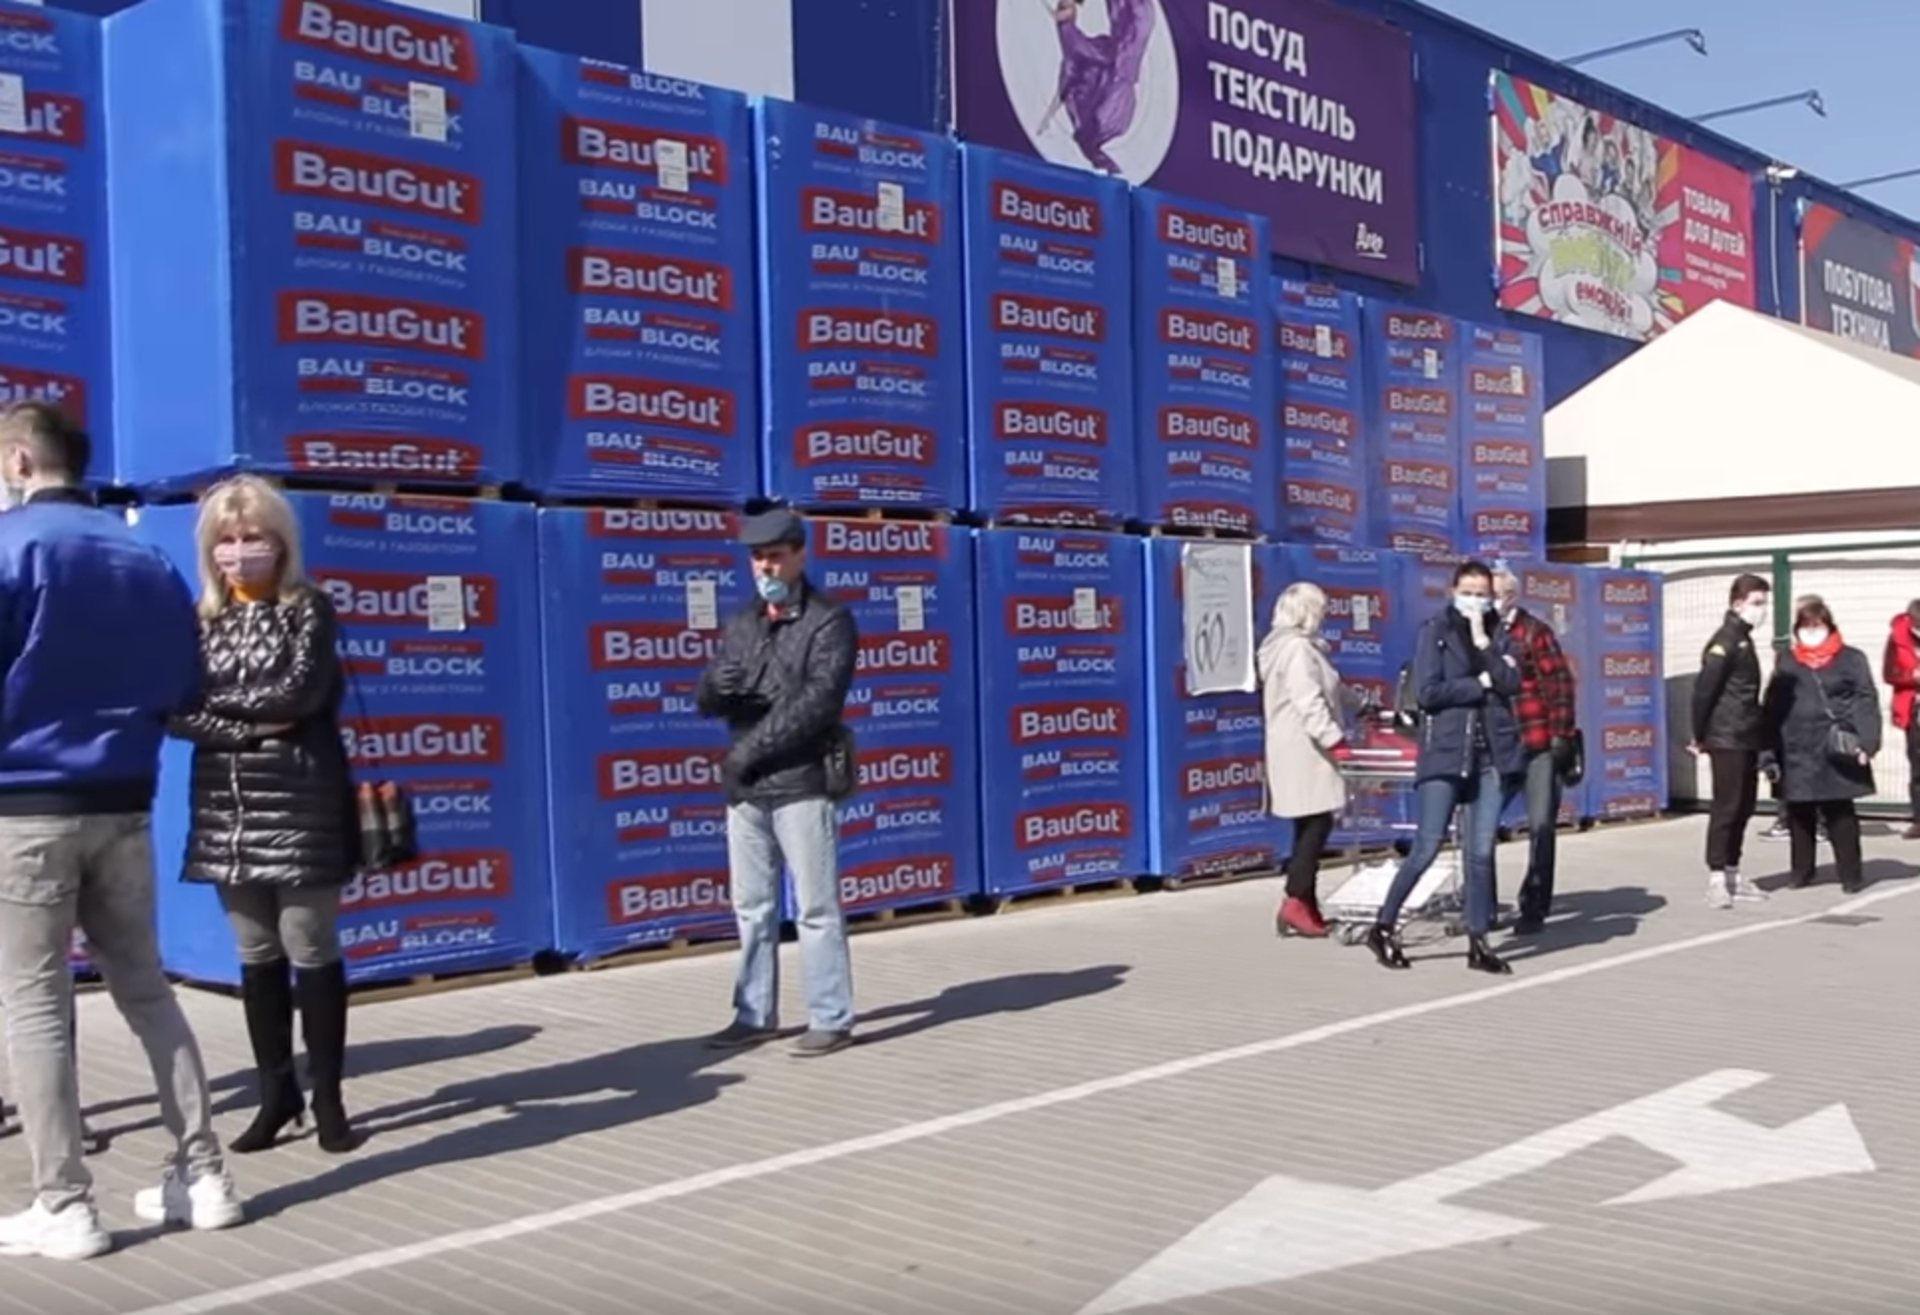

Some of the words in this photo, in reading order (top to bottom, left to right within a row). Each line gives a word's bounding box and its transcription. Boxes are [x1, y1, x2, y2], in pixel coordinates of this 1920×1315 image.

[298, 1, 459, 71] BauGut
[1208, 1, 1306, 77] ПОСУД
[294, 61, 361, 91] BAU
[630, 73, 704, 100] BLOCK
[1207, 60, 1356, 142] ТЕКСТИЛЬ
[362, 95, 462, 133] BLK
[815, 123, 858, 144] BAU
[578, 126, 713, 175] Bauut
[859, 148, 926, 170] BLOCK
[1211, 120, 1383, 205] ПОДАРУНКИ
[294, 151, 465, 214] BauGut
[579, 179, 635, 200] BAU
[637, 202, 717, 229] BLOCK
[1001, 189, 1092, 230] BauGut
[294, 210, 361, 235] BAU
[1168, 215, 1246, 251] BauGut
[363, 237, 466, 272] BLOCK
[812, 245, 858, 260] BAU
[1000, 234, 1037, 252] BAU
[859, 262, 927, 284] BLOCK
[1038, 254, 1094, 275] BLOCK
[582, 256, 719, 301] BauGut
[1823, 259, 1895, 315] ПОБУТОВА
[296, 299, 466, 350] BauGut
[584, 308, 640, 325] BAU
[1001, 300, 1095, 335] BauGut
[641, 328, 720, 355] BLOCK
[809, 315, 924, 349] BauGut
[1168, 314, 1250, 350] BauGut
[1001, 344, 1039, 358] BAU
[298, 358, 365, 376] BAU
[809, 361, 856, 376] BAU
[1040, 360, 1096, 379] BLOCK
[365, 378, 468, 406] BLOCK
[856, 376, 926, 396] BLOCK
[585, 383, 720, 426] BauGut
[1003, 408, 1096, 439] BauGut
[1168, 413, 1251, 444] BauGut
[586, 432, 642, 449] BAU
[809, 430, 923, 460] BauGut
[643, 452, 720, 477] BLOCK
[1005, 451, 1043, 464] BAU
[1043, 464, 1098, 482] BLOCK
[387, 513, 476, 534] BLOCK
[826, 524, 932, 551] BauGut
[1018, 536, 1055, 551] BAU
[602, 553, 654, 569] BAU
[1054, 552, 1109, 567] BLOCK
[825, 572, 868, 587] BAU
[869, 586, 937, 601] BLK
[856, 640, 938, 670] auGut
[1017, 646, 1056, 661] BAU
[1057, 659, 1115, 672] BLOCK
[387, 658, 485, 675] BLOCK
[607, 682, 661, 700] BAU
[872, 698, 939, 717] BLOCK
[1020, 707, 1117, 738] BauGut
[858, 752, 940, 785] auGut
[1022, 751, 1060, 769] BAU
[1060, 760, 1120, 776] BLOCK
[413, 796, 492, 815] LOCK
[616, 807, 669, 828] BAU
[876, 810, 942, 829] BLOCK
[1025, 808, 1120, 843] BauGut
[840, 861, 942, 902] BauGut
